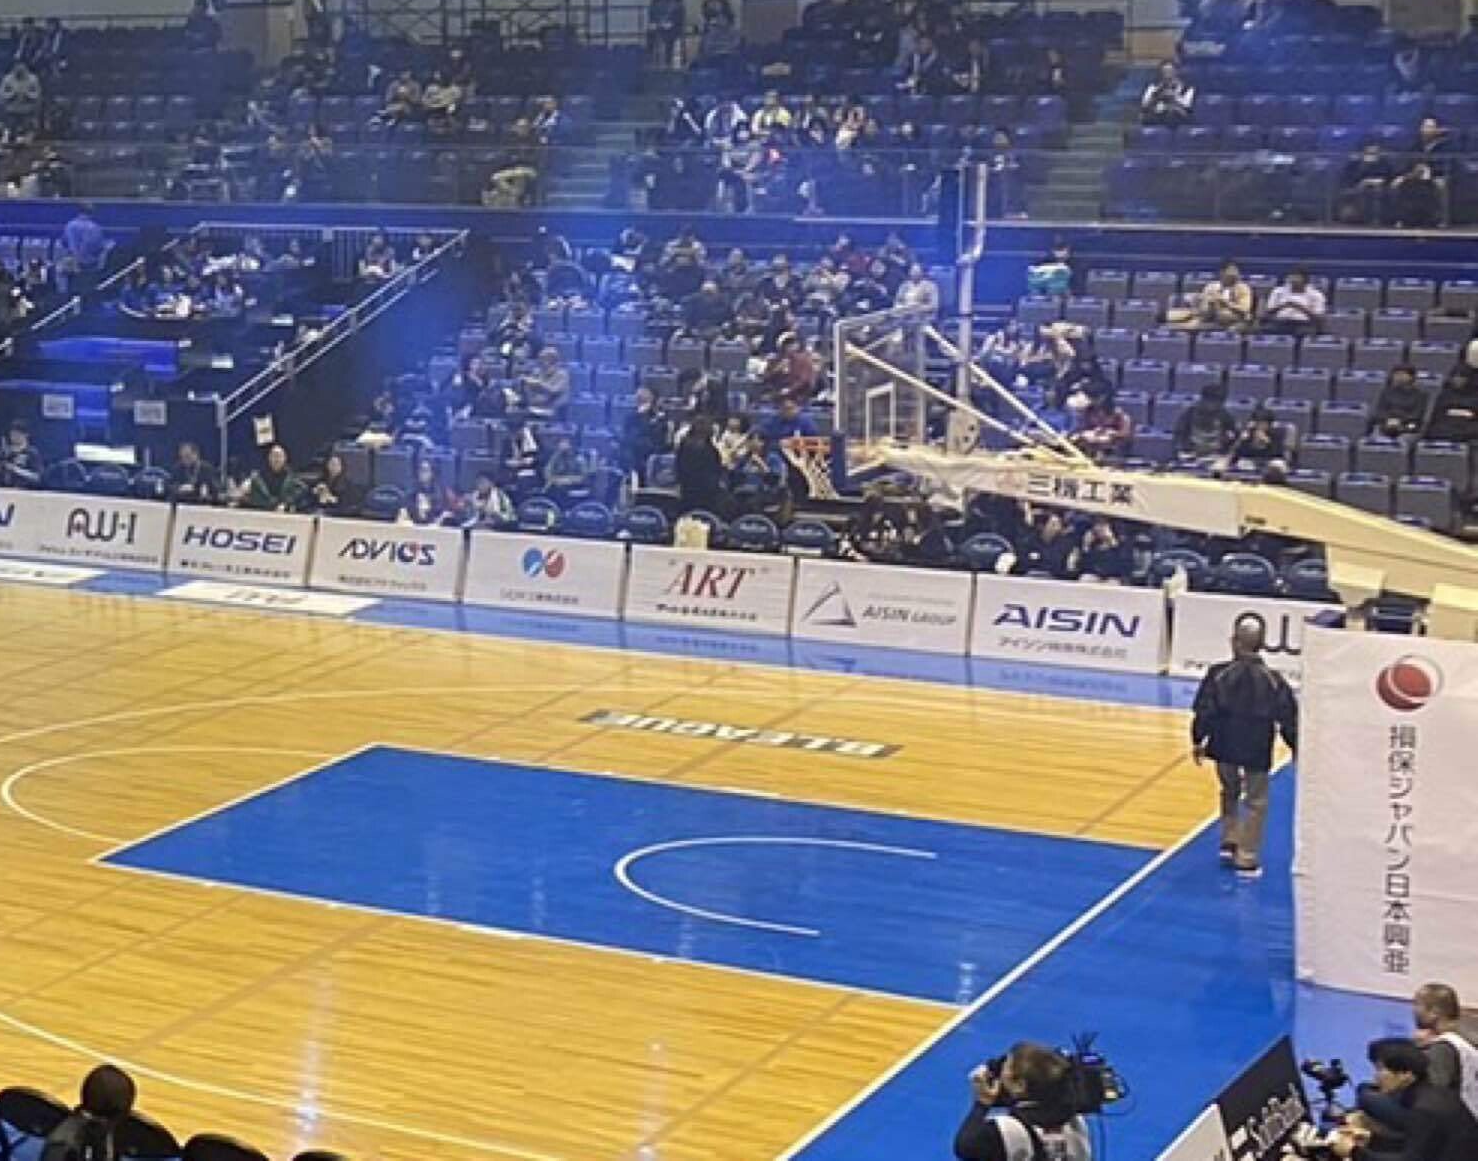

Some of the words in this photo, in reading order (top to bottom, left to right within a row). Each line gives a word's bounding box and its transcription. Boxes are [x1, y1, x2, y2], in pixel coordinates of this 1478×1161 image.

[1027, 472, 1134, 504] 三機工業
[182, 524, 297, 556] HOSEI
[339, 536, 437, 566] ADVICS
[861, 602, 909, 624] AISIN
[910, 610, 958, 627] GROUP
[992, 602, 1142, 640] AISIN
[1381, 724, 1417, 976] 損保ジャパン日本興亜
